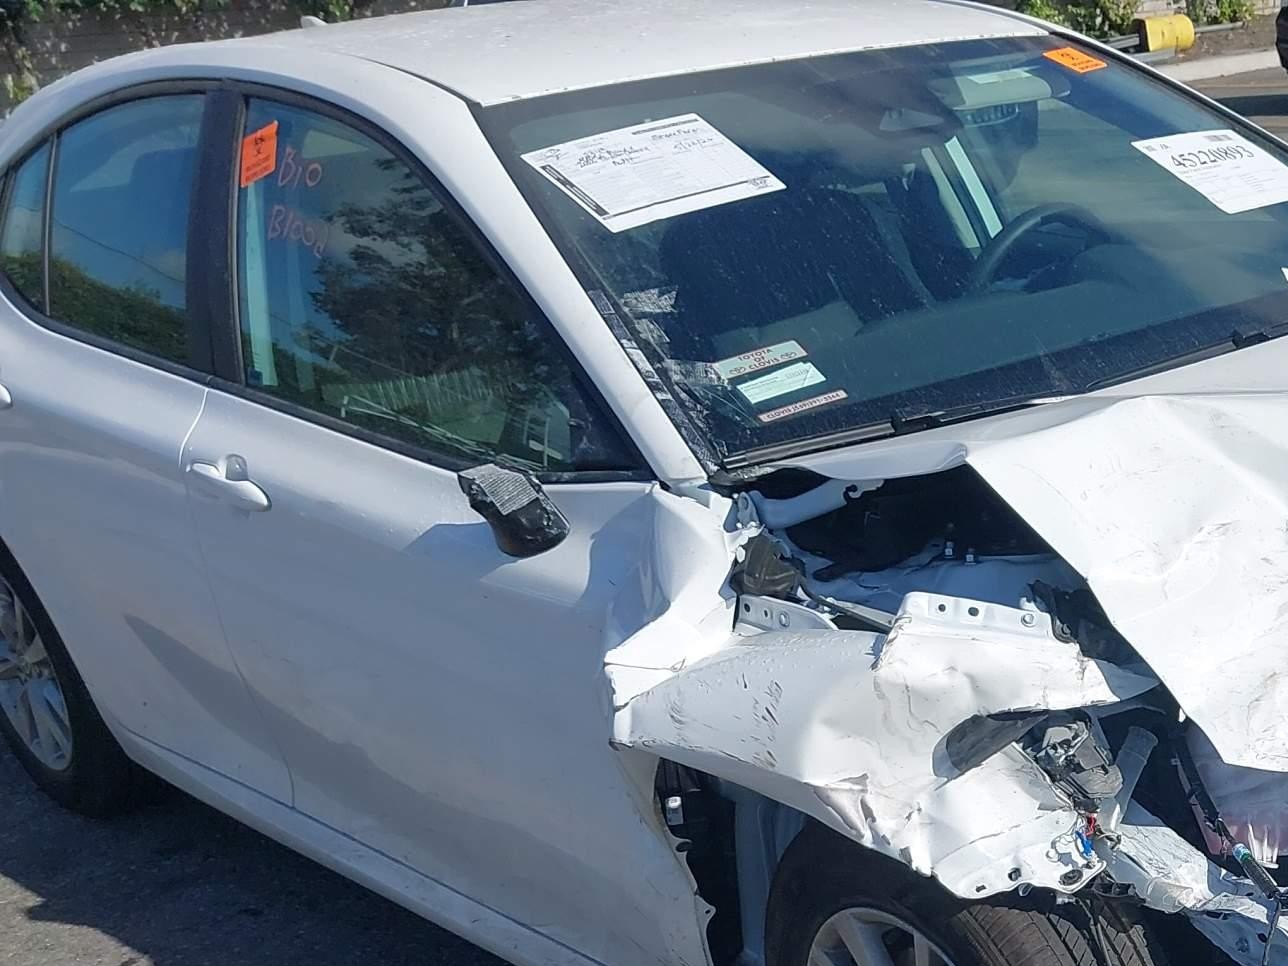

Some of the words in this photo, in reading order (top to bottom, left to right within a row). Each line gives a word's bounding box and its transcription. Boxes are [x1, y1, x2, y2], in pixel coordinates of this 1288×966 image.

[1169, 144, 1255, 169] 45220893
[738, 348, 773, 361] TOYOTA
[754, 355, 766, 363] OF
[748, 356, 780, 370] CLOVIS
[766, 407, 791, 420] CLOVIS
